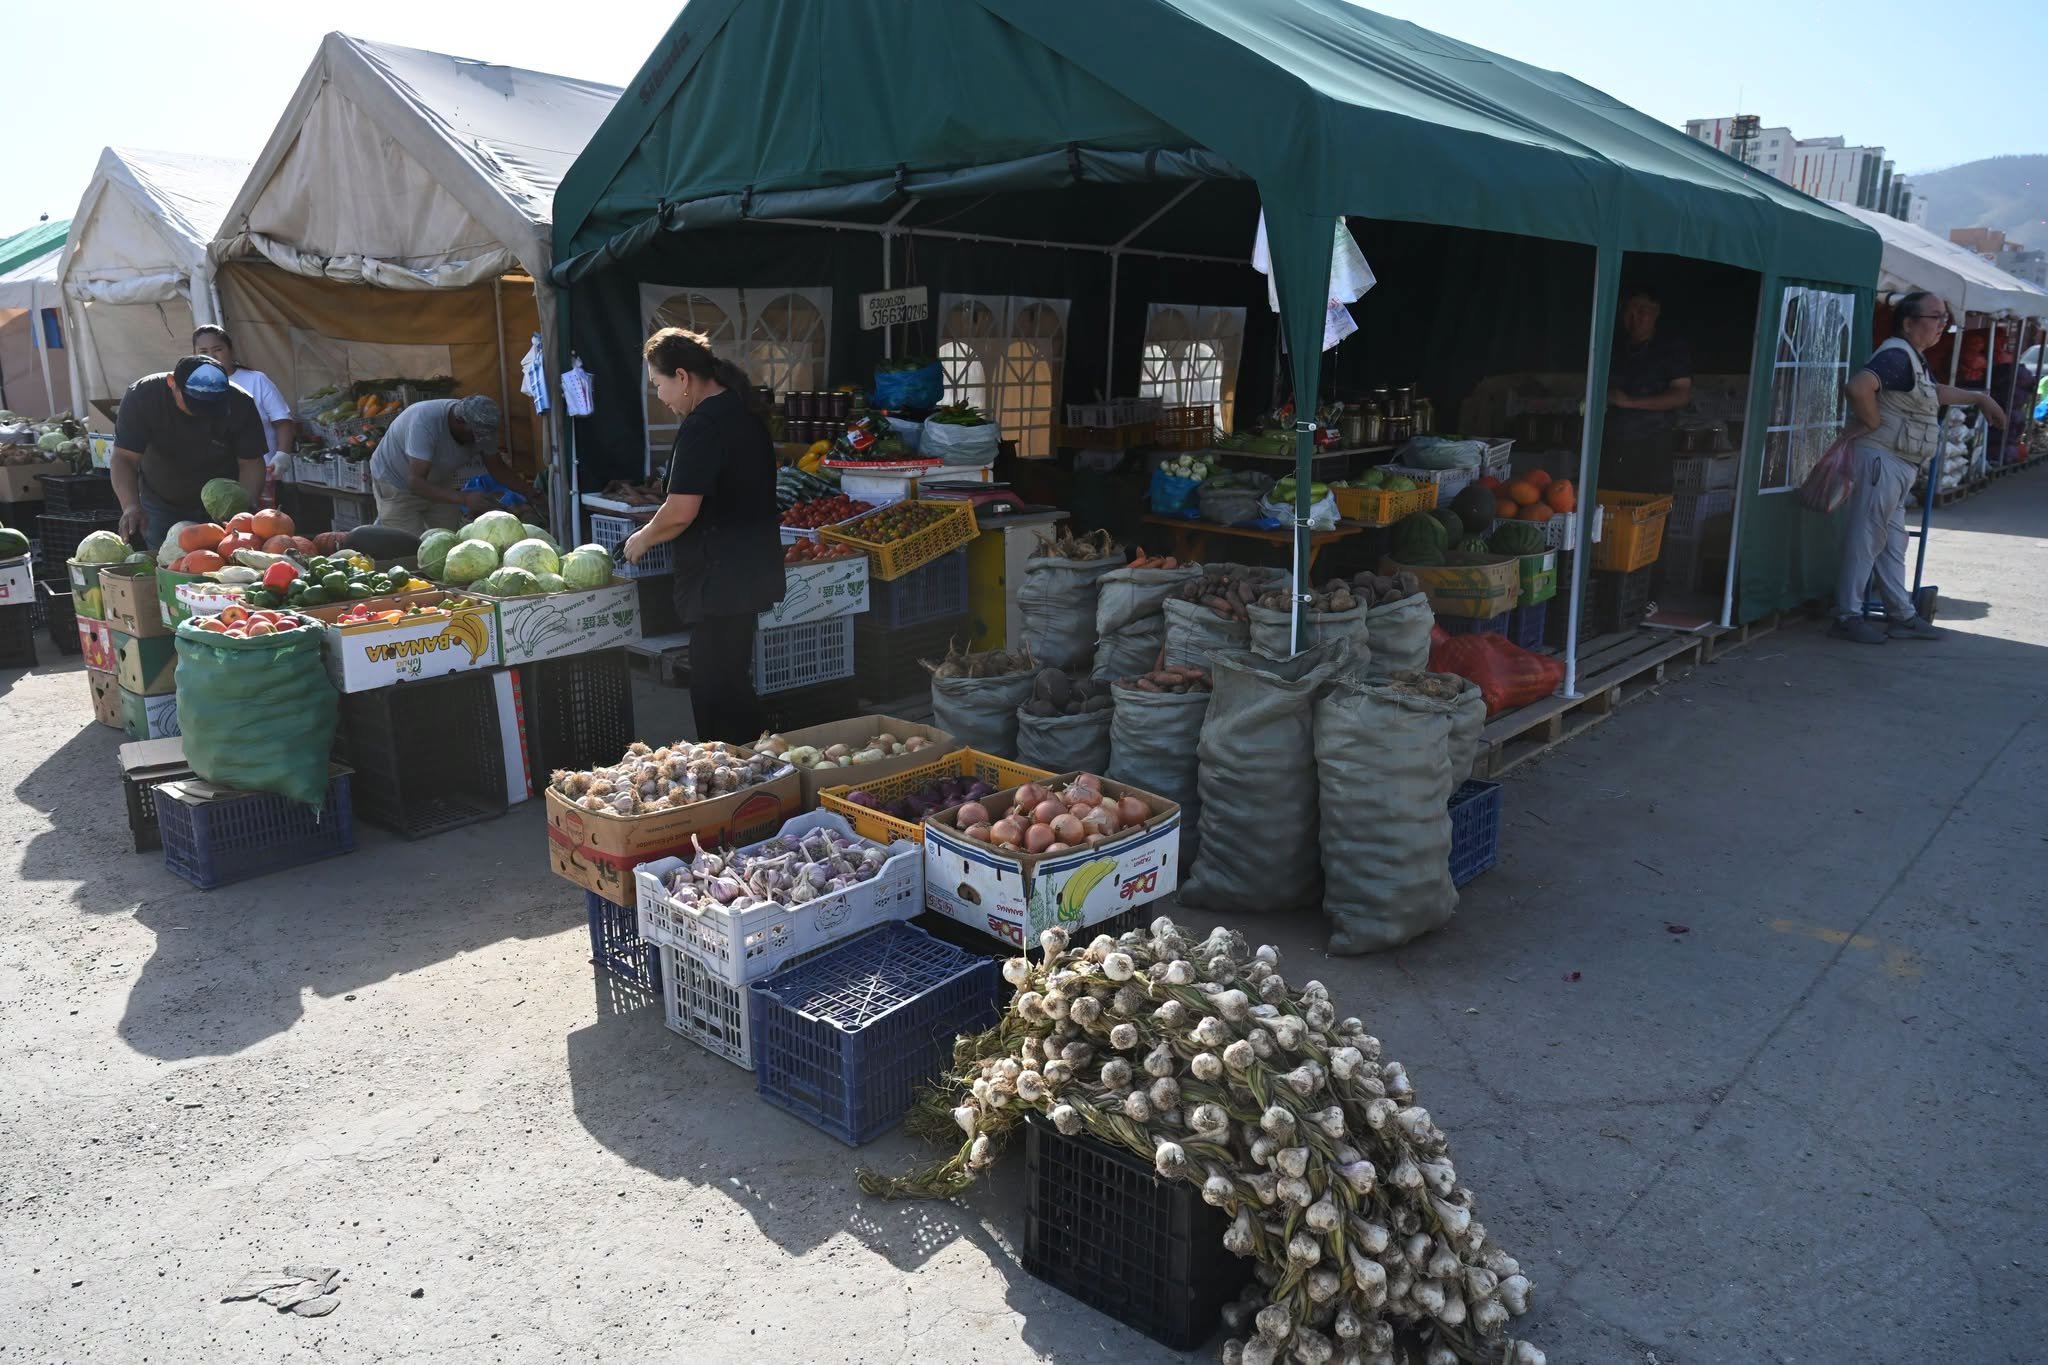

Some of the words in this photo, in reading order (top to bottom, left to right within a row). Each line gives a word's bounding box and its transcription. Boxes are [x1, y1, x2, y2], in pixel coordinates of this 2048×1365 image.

[365, 634, 450, 663] BANANA
[1119, 871, 1158, 901] Dole
[996, 904, 1024, 917] BANANAS
[988, 918, 1023, 946] Dole
